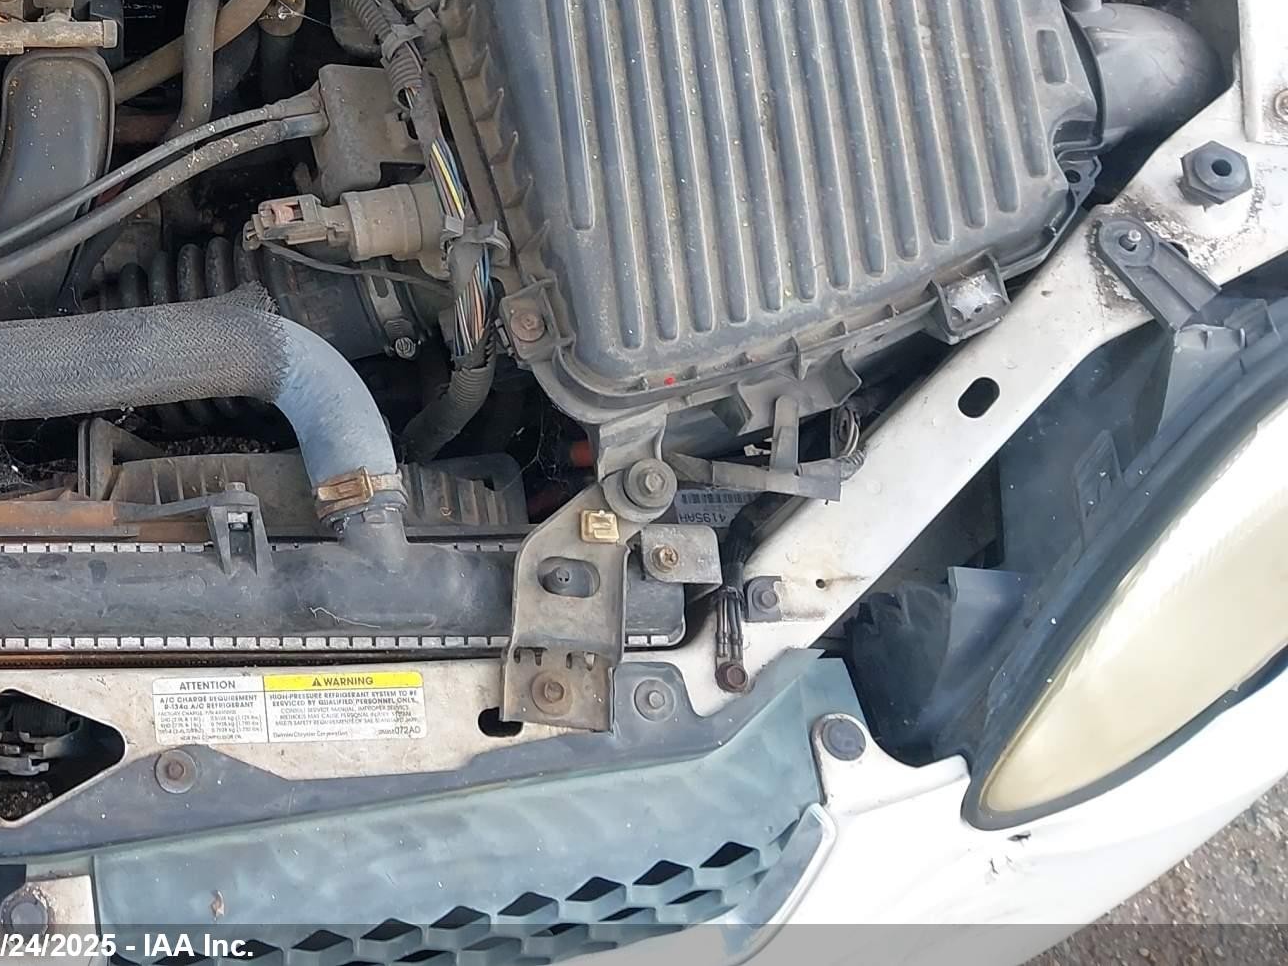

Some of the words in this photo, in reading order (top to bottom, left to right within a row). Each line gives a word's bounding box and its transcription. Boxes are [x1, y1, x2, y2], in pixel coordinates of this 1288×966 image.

[179, 680, 236, 690] ATTENTION
[323, 676, 374, 687] WARNING
[209, 694, 258, 703] REQUIREMENT
[269, 692, 322, 701] HIGH-PRESSURE
[323, 691, 370, 699] REFRIGERANT
[371, 690, 397, 698] SYSTEM
[206, 701, 254, 709] REFRIGERANT
[272, 699, 306, 707] SERVICED
[318, 698, 354, 706] QUALIFIED
[355, 697, 395, 705] PERSONNEL
